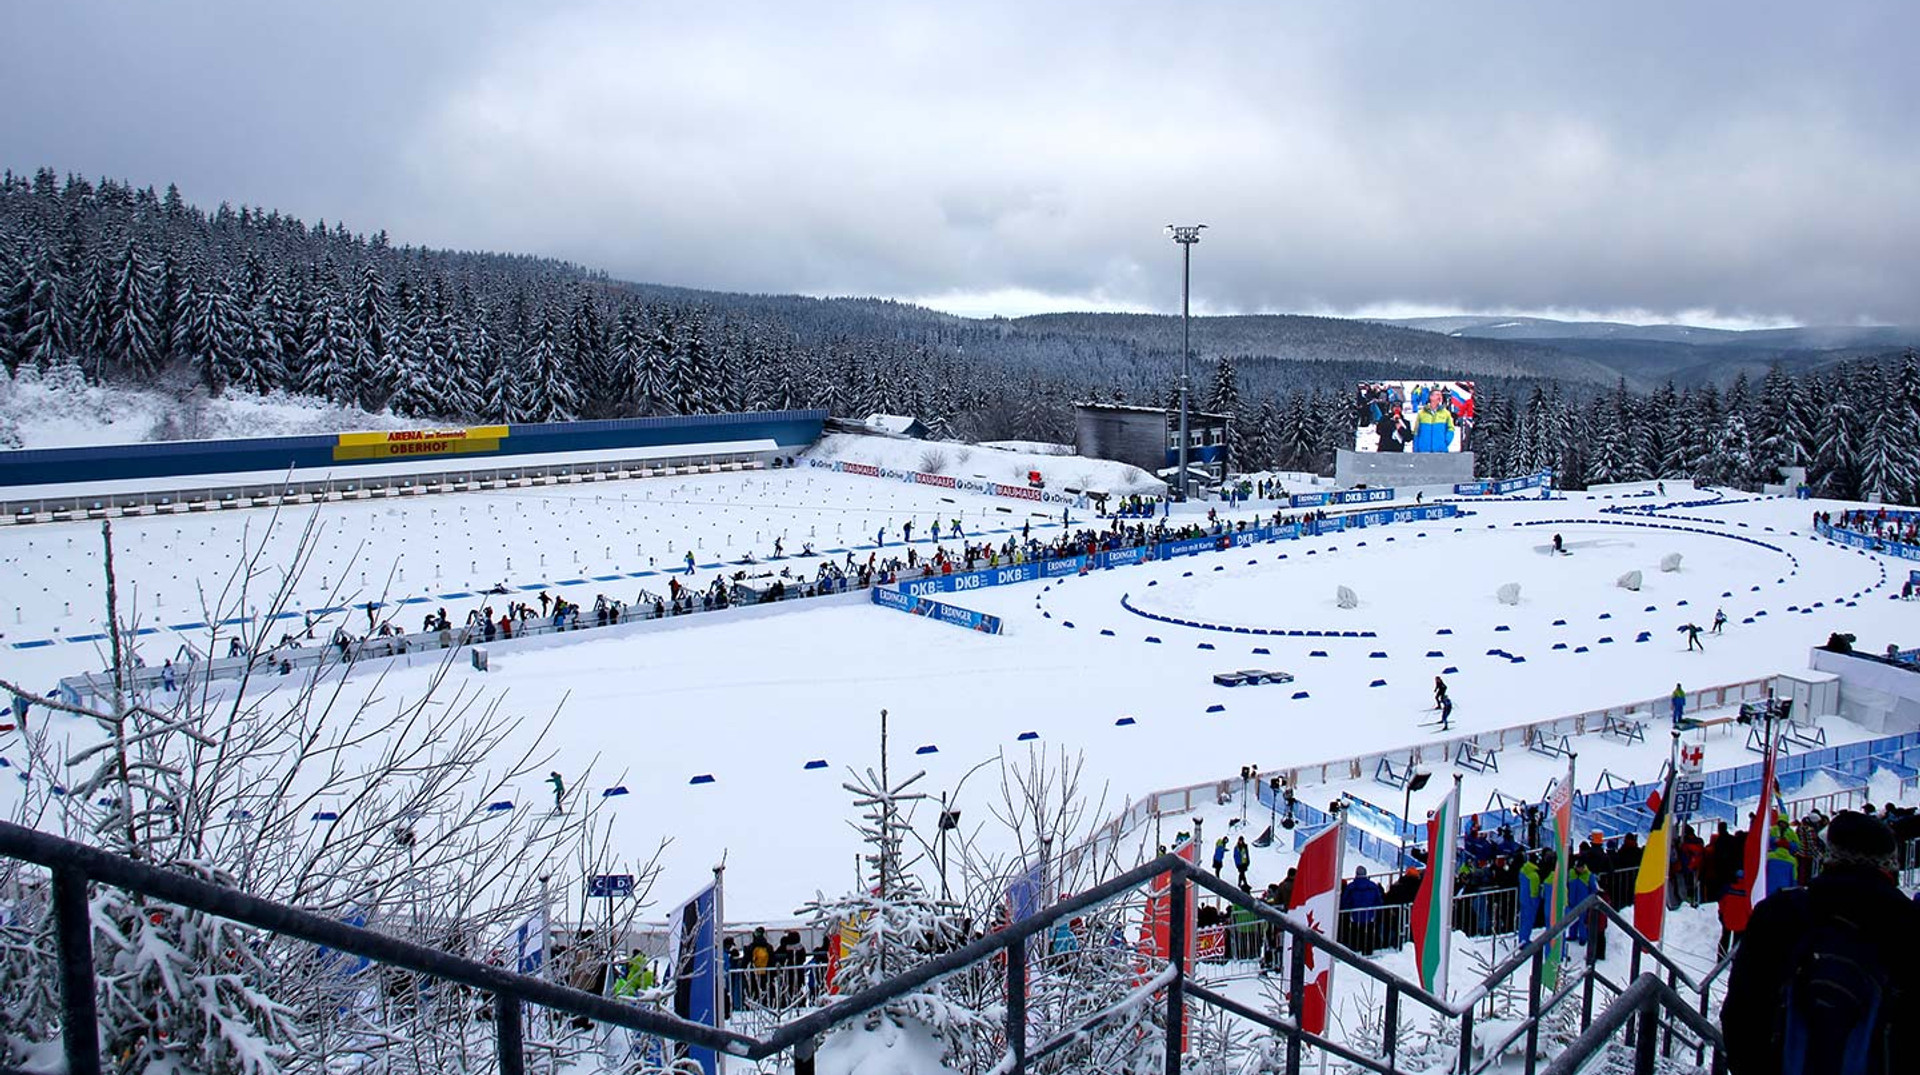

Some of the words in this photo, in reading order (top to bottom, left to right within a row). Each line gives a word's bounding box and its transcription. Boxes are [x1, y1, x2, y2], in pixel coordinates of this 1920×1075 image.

[387, 431, 423, 441] ARENA
[390, 441, 449, 454] OBERHOF
[996, 485, 1041, 500] BAUHAUS
[1345, 493, 1362, 503] DKB
[1369, 491, 1386, 501] DKB
[1051, 494, 1073, 505] xDrive
[1393, 511, 1412, 522] DKB
[1425, 509, 1443, 518] DKB
[1236, 533, 1254, 545] DKB
[1109, 549, 1137, 561] ERDINGER
[1047, 559, 1077, 571] ERDINGER
[955, 575, 980, 590] DKB
[998, 569, 1022, 584] DKB
[910, 581, 936, 596] DKB
[880, 589, 908, 606] ERDINGER
[941, 604, 972, 622] ERDINGER
[596, 880, 603, 888] C
[617, 880, 625, 888] D
